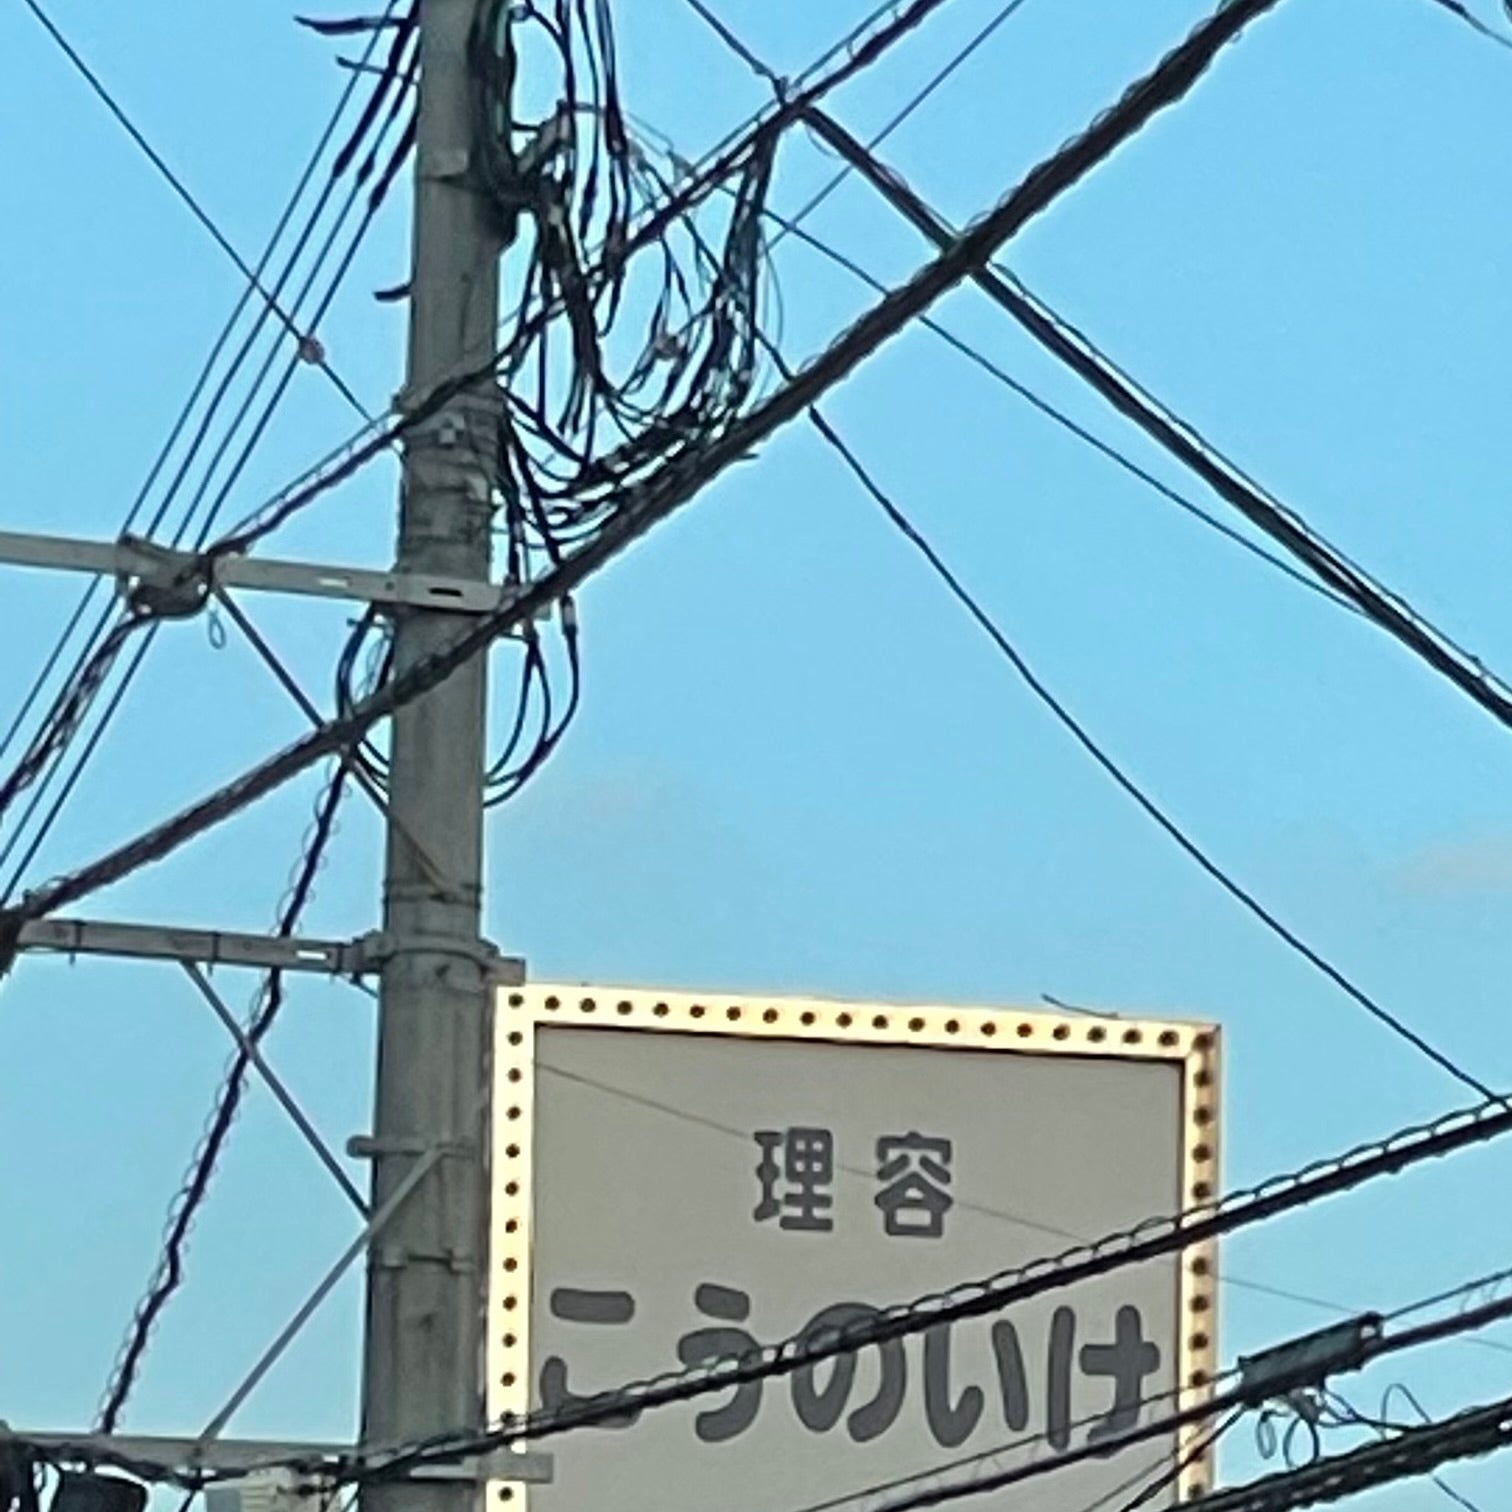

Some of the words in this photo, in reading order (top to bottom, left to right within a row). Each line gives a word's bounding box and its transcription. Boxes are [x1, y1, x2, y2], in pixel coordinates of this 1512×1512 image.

[754, 1127, 953, 1237] 理容
[540, 1283, 1160, 1457] こうのいけ
